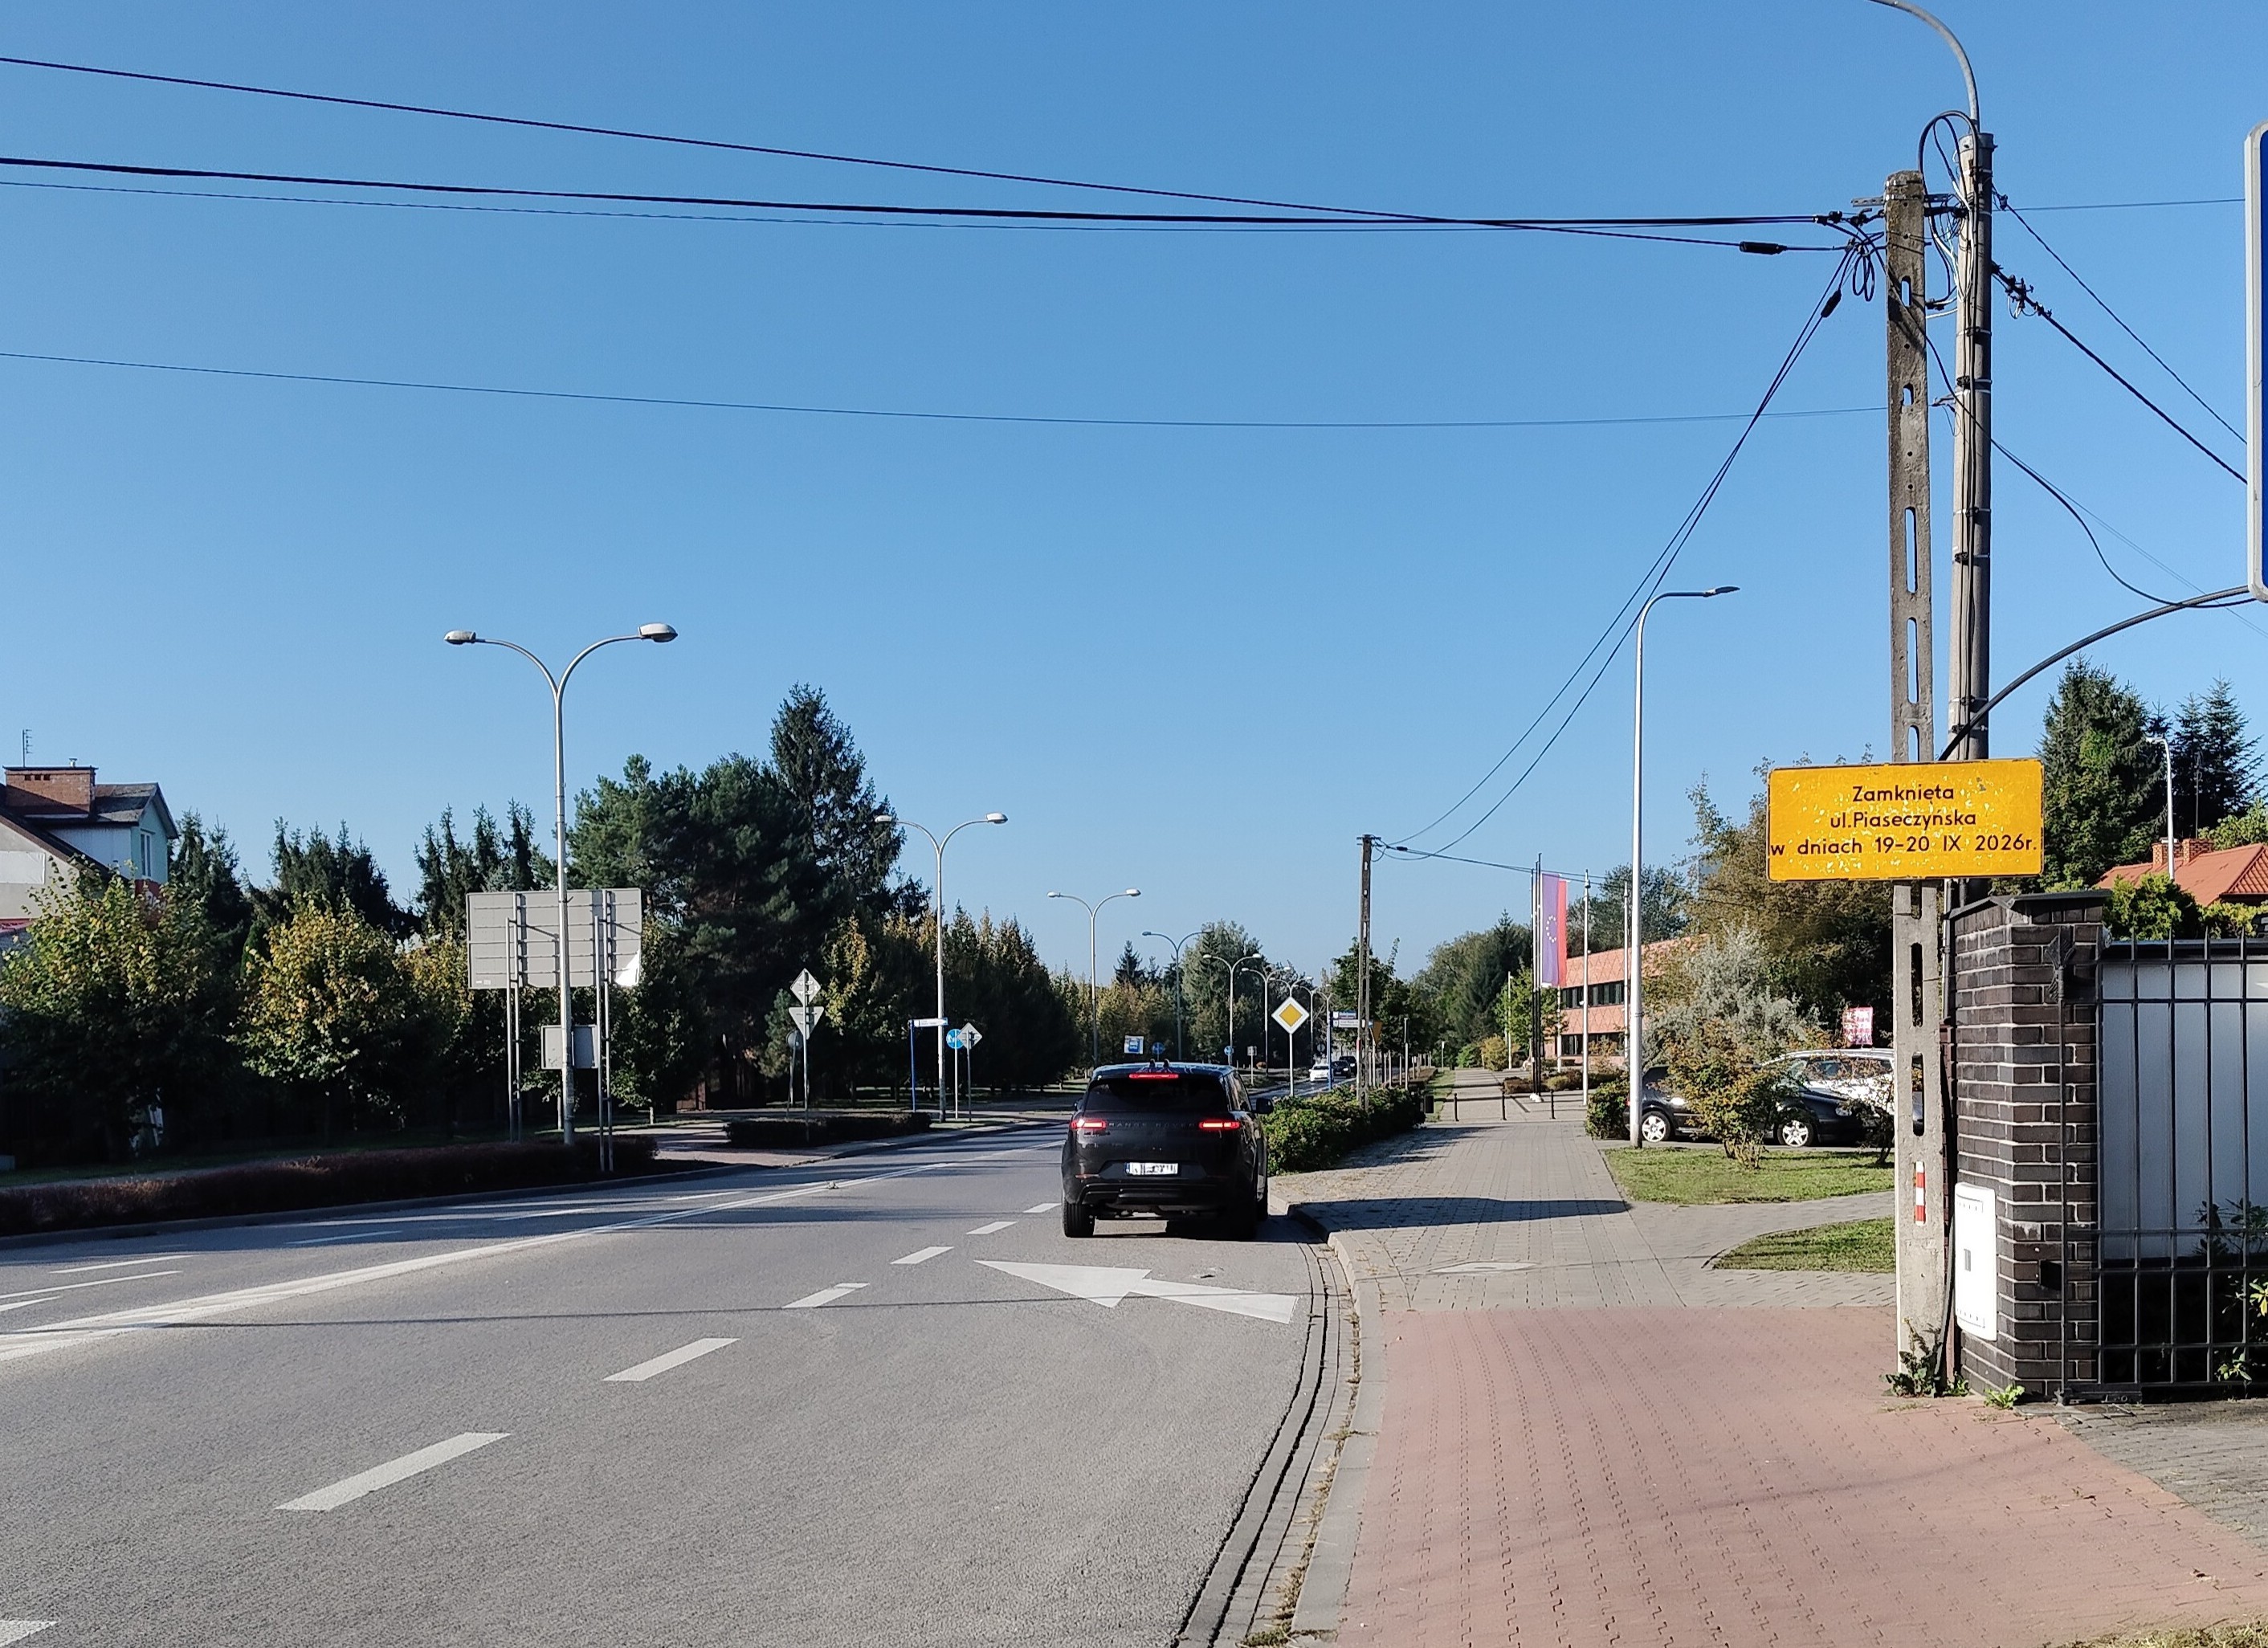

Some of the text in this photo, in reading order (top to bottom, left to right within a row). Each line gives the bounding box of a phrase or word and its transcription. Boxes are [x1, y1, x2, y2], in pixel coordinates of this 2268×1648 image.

[1771, 833, 2038, 856] w dniach 19-20 IX 2026r.
